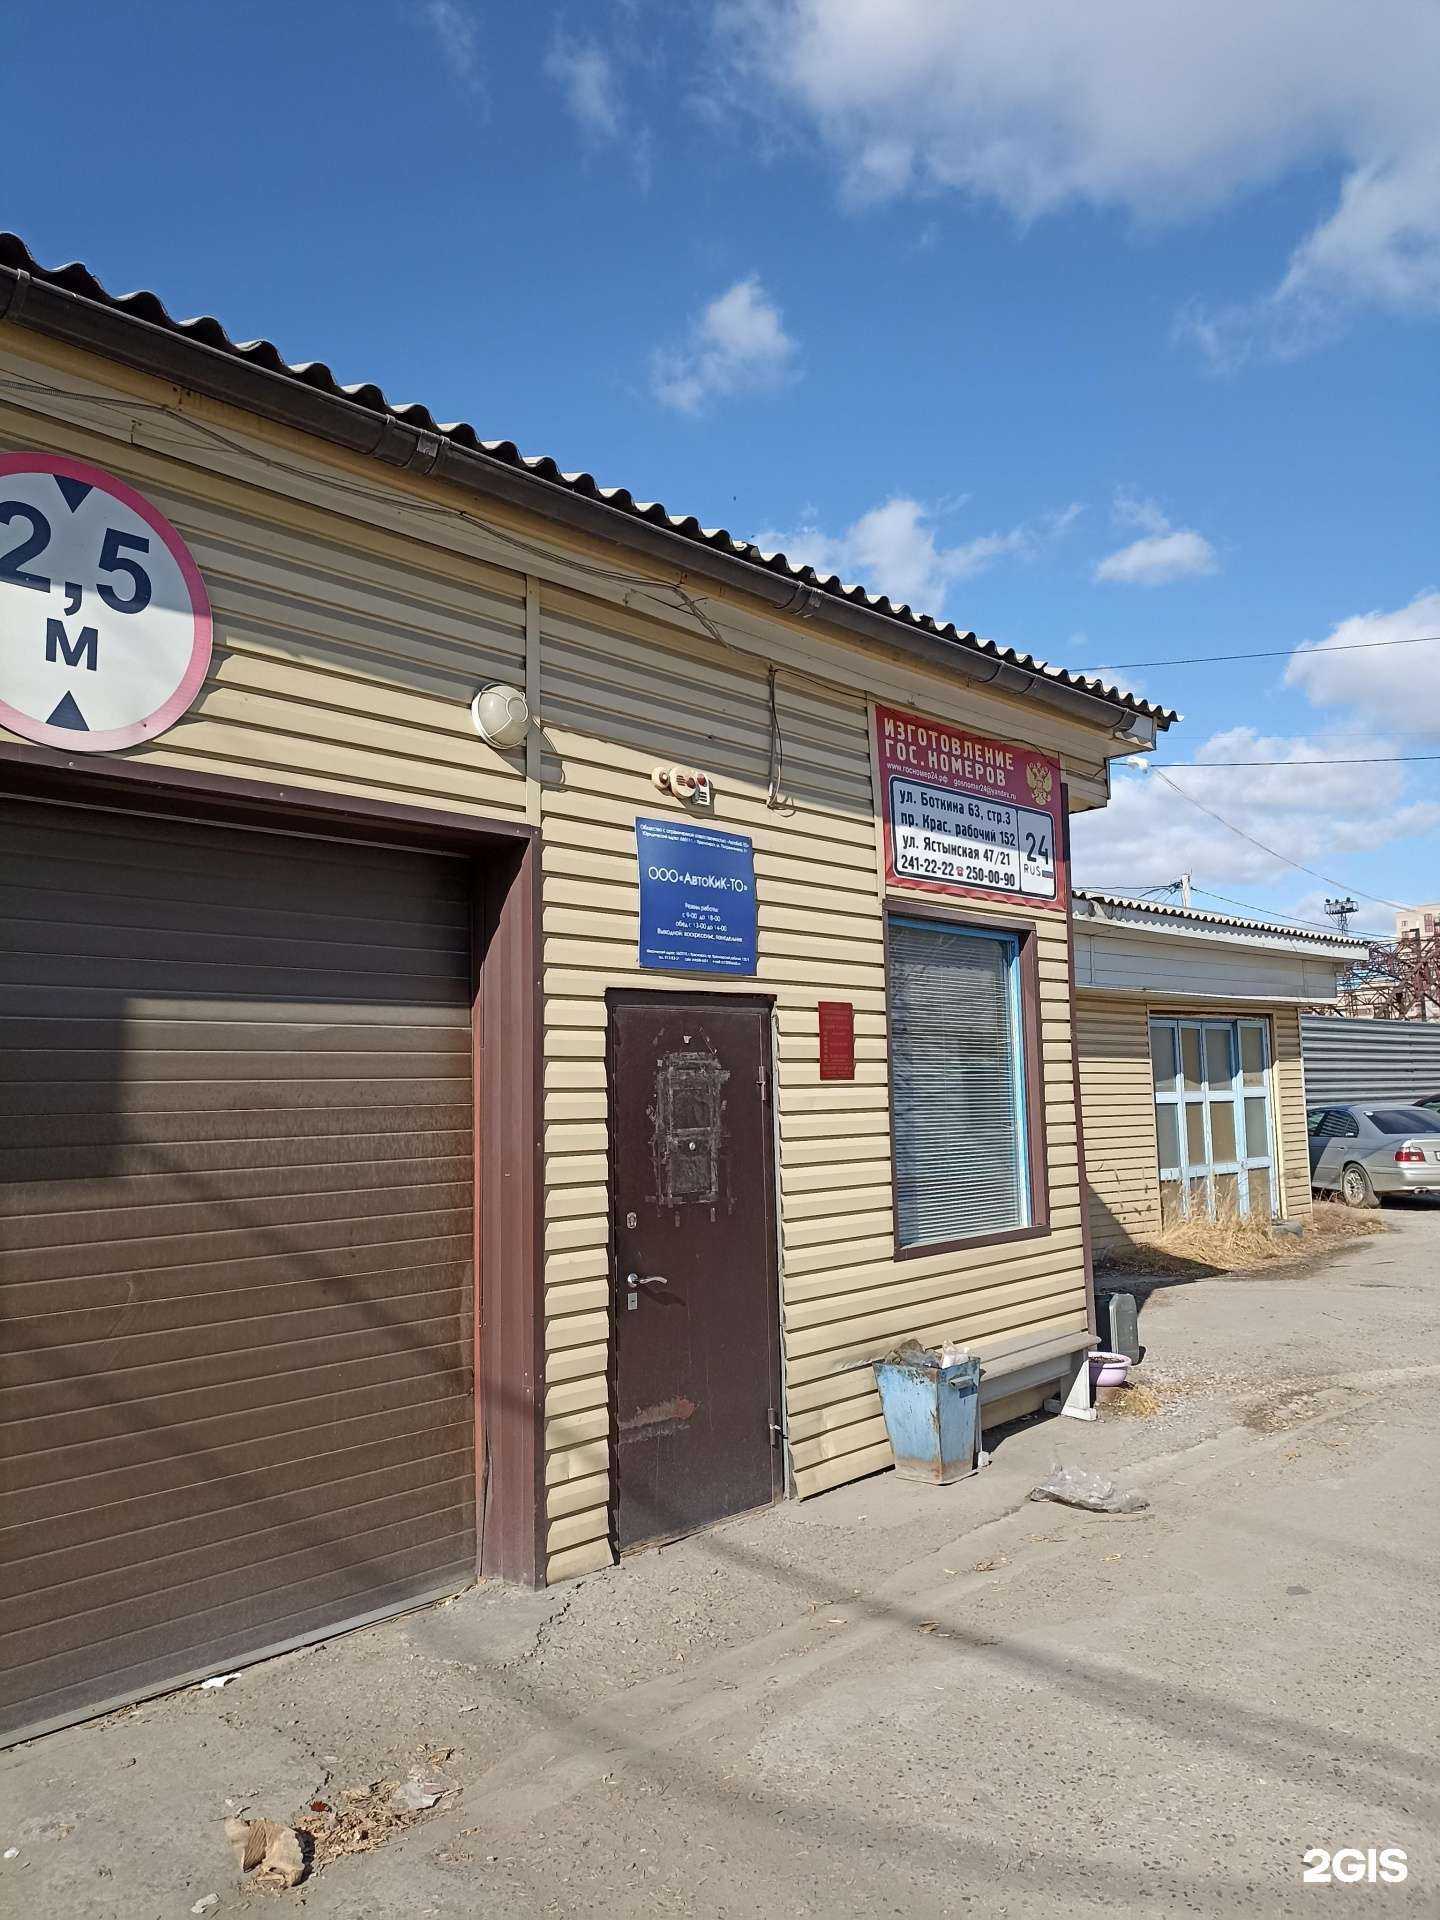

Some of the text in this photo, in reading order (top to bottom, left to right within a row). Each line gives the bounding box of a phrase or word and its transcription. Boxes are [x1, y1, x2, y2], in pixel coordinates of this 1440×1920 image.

[0, 501, 151, 615] 2,5
[884, 717, 1014, 770] ИЗГОТОВЛЕНИЕ
[886, 762, 1017, 800] www.госномер24.рф gosnomer24@yandex.ru
[900, 790, 1011, 825] ул. Боткина 63, стр.3
[901, 812, 1016, 847] пр. Крас. рабочий 152
[902, 836, 1011, 866] ул. Ястынская 47/21
[1025, 832, 1049, 865] 24
[901, 855, 1015, 887] 241-22-22 250-00-90
[1024, 864, 1042, 877] RUS
